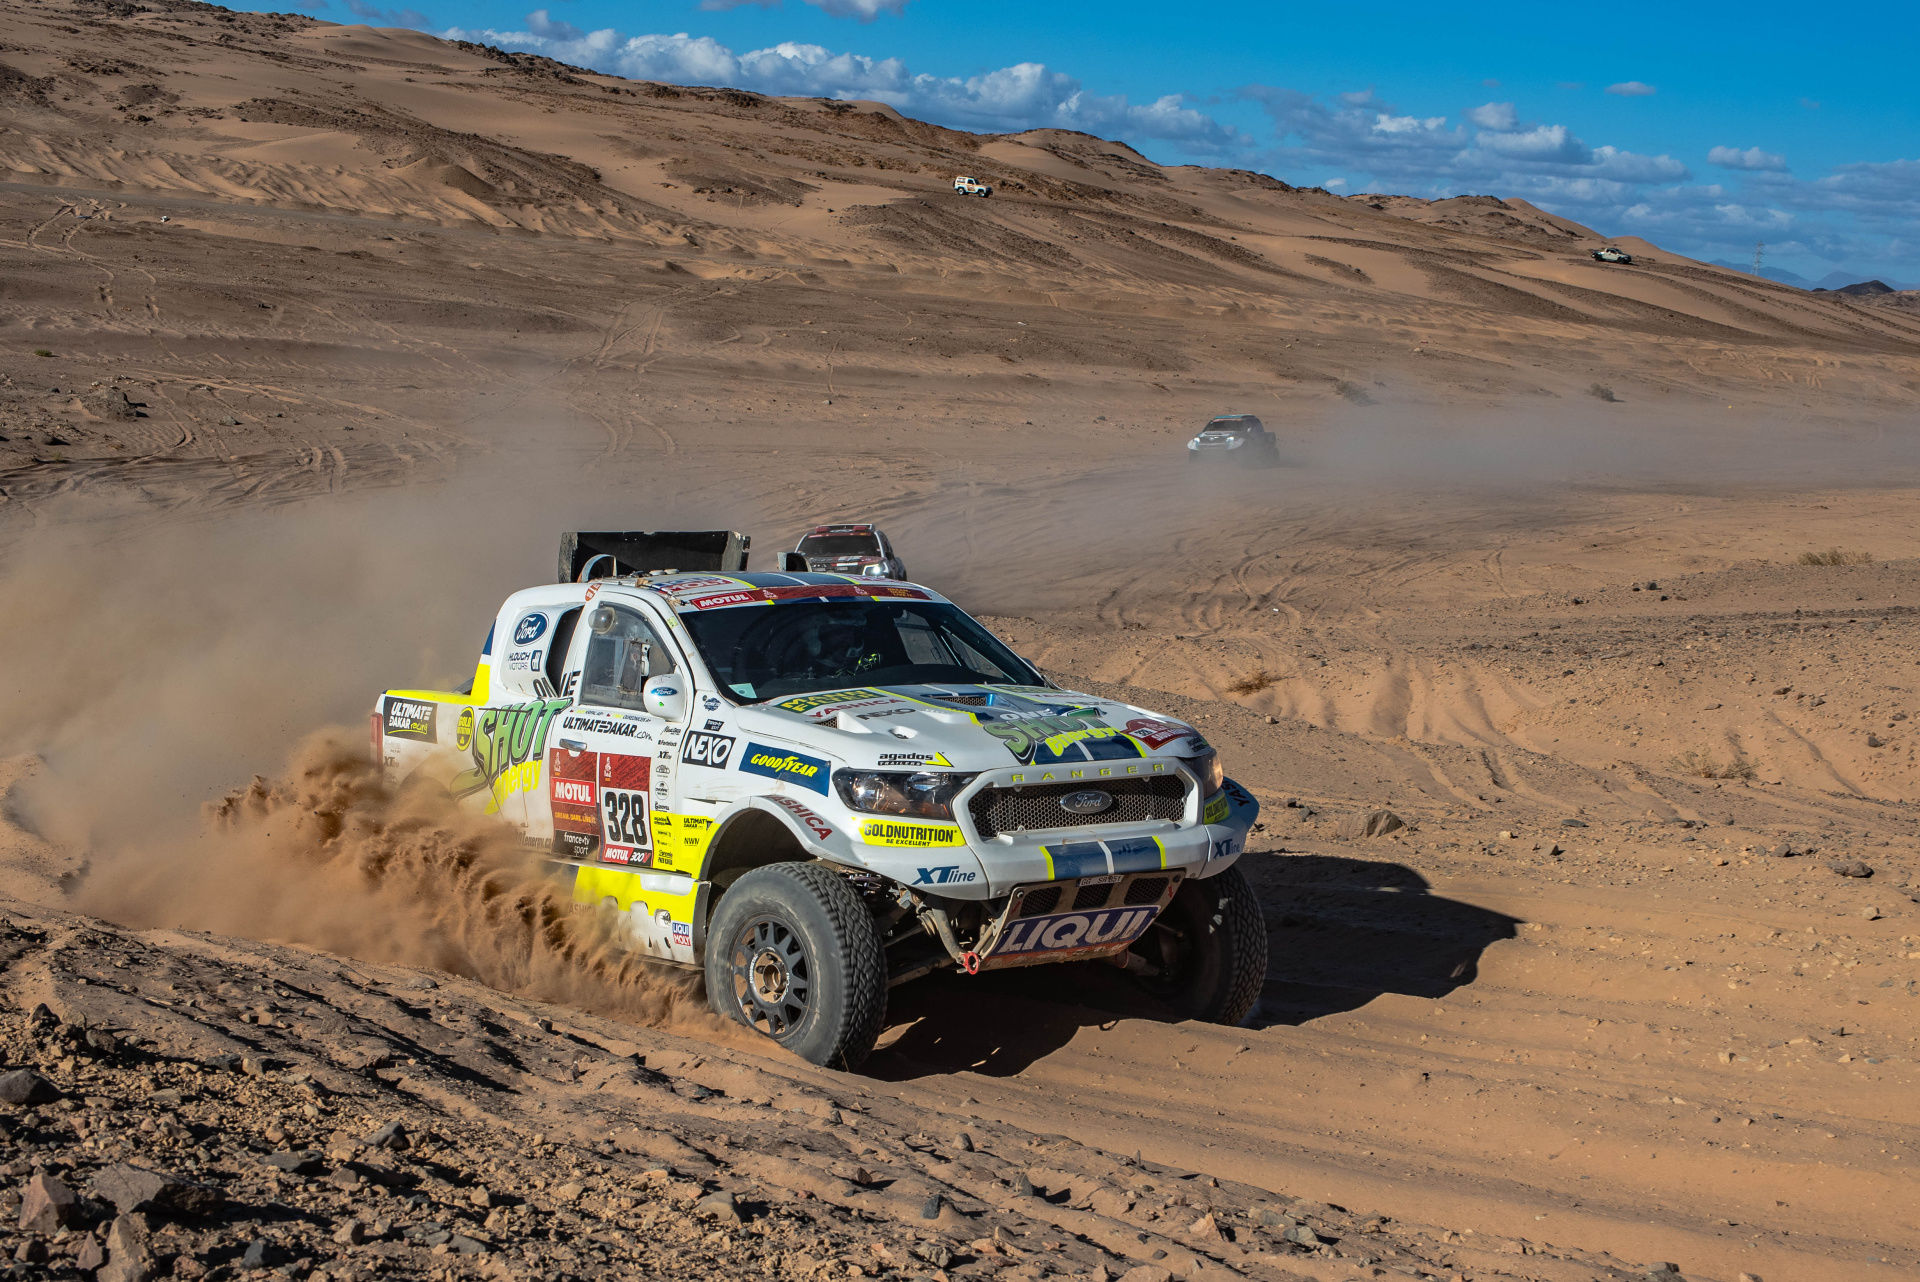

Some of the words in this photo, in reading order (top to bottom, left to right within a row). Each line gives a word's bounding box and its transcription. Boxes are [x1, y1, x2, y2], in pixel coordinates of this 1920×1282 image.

[700, 594, 749, 608] MOTUL
[516, 617, 542, 643] Ford
[391, 702, 433, 721] ULTIMATE
[808, 698, 907, 719] YASHICA
[389, 717, 411, 729] DAKAR
[984, 707, 1112, 764] SHOT
[1045, 727, 1122, 757] energy
[453, 697, 573, 799] SHOT
[684, 734, 732, 766] NEXO
[879, 752, 933, 761] agados
[750, 753, 818, 778] GOODYEAR
[1012, 763, 1165, 783] RANGER
[555, 781, 592, 802] MOTUL
[1073, 793, 1104, 809] Ford
[604, 791, 648, 845] 328
[574, 846, 589, 858] sport
[896, 839, 931, 847] EXCELLENT
[605, 847, 629, 860] MOTUL
[910, 865, 976, 886] XTline
[673, 923, 690, 936] LIQUI
[998, 910, 1151, 954] LIQUI
[674, 934, 691, 946] MOLY
